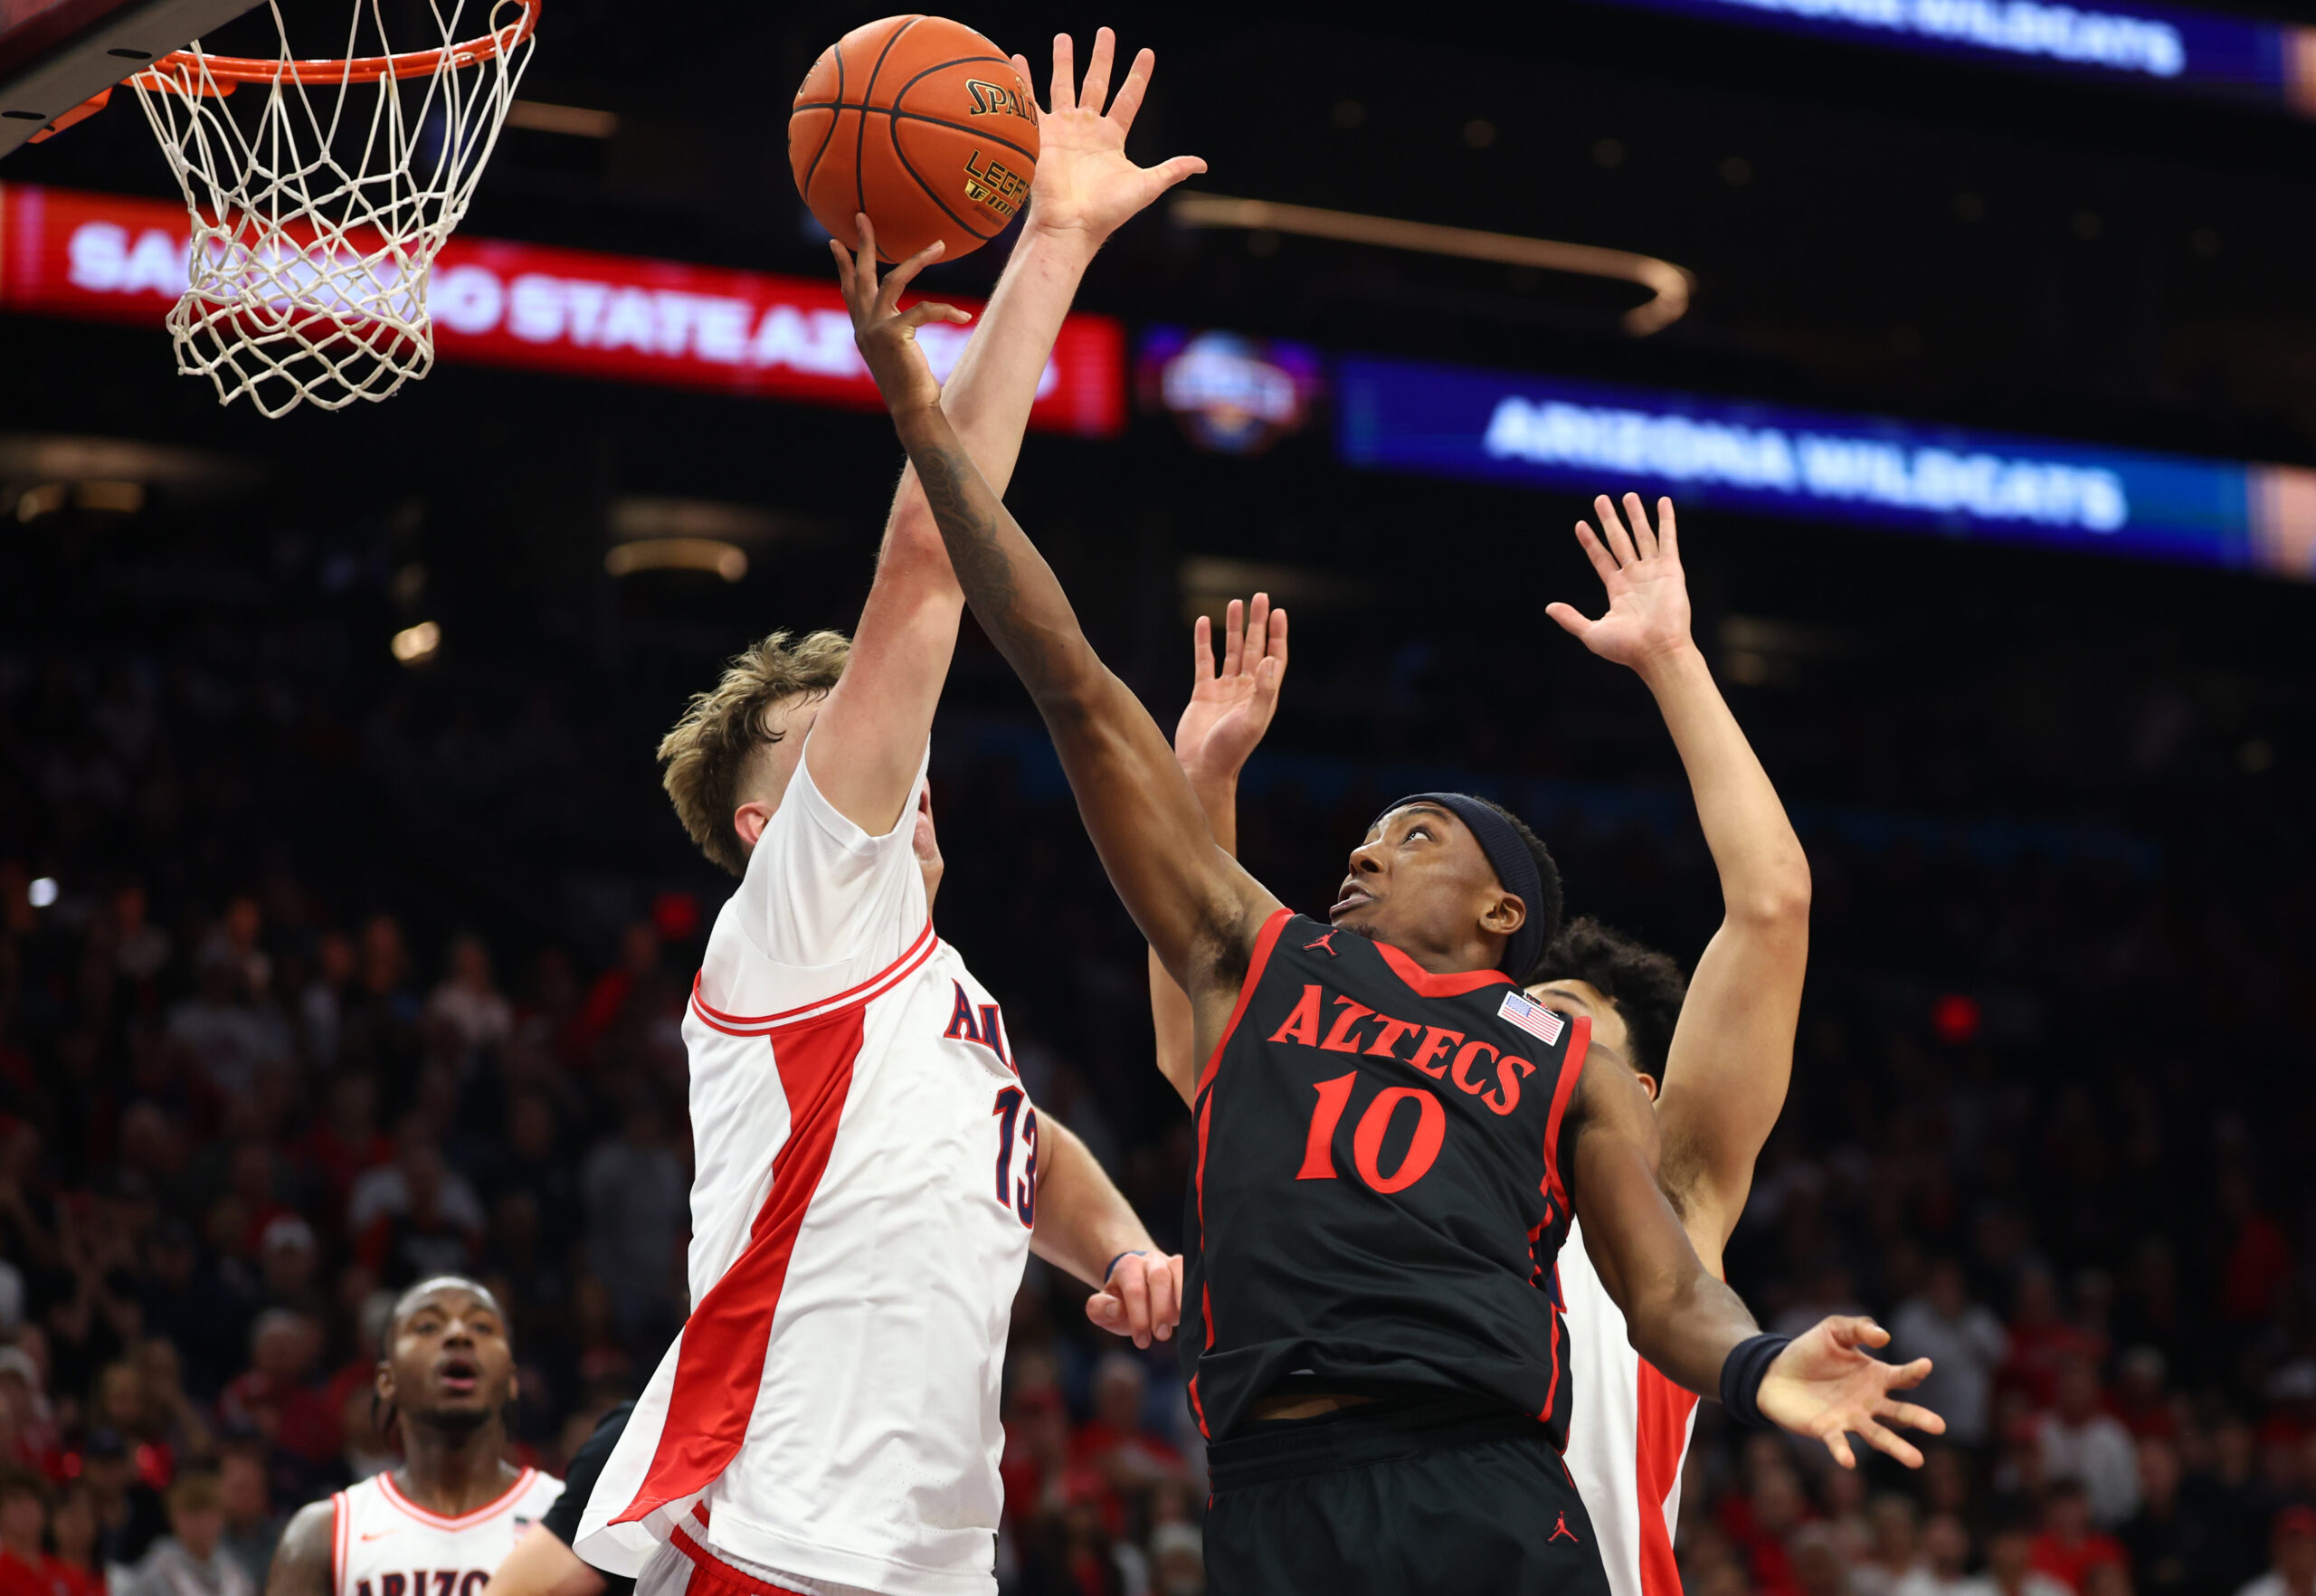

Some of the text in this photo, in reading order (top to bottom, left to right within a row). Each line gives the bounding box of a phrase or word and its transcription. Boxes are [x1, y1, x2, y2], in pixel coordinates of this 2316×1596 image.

[965, 78, 1039, 131] SPALD
[964, 149, 1030, 203] LEGA
[508, 271, 753, 362] STATE
[1485, 395, 2126, 532] ARIZONA WILDCATS
[1267, 984, 1537, 1116] AZTECS
[992, 1085, 1039, 1230] 13
[1295, 1069, 1447, 1195] 10
